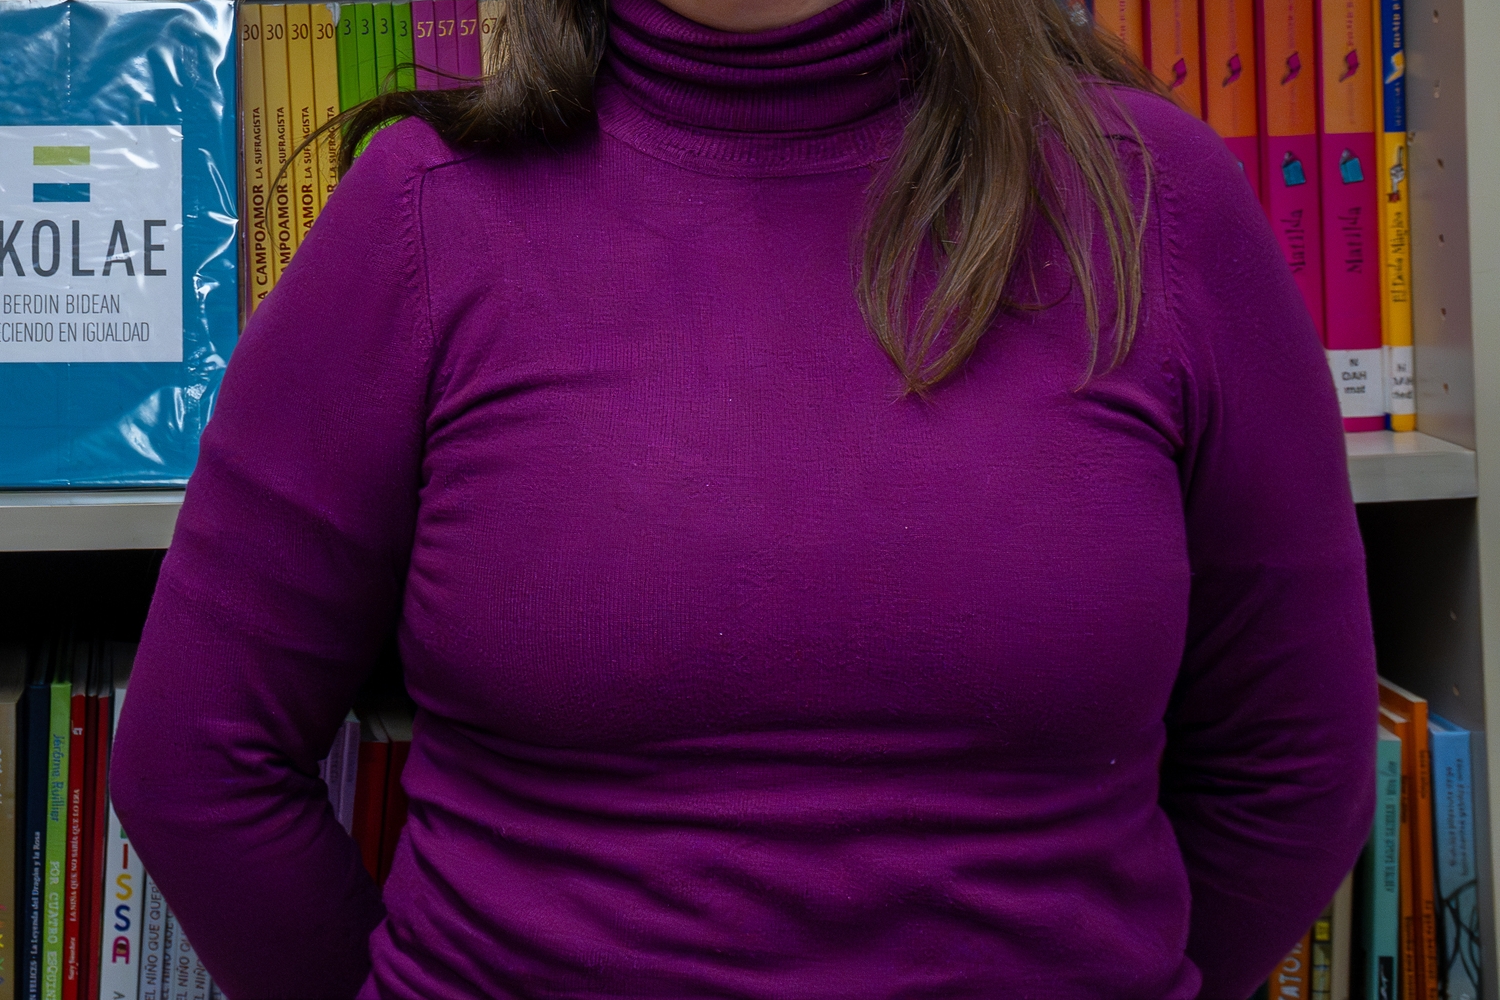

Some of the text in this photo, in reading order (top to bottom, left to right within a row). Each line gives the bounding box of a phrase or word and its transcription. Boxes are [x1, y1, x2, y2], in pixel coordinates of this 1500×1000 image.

[266, 23, 284, 40] 30
[417, 22, 434, 38] 57
[253, 108, 268, 285] CAMPOAMOR LA SUFRAGISTA
[3, 295, 120, 314] BERDIN BIDEAN
[59, 322, 77, 342] EN
[82, 322, 149, 342] IGUALDAD
